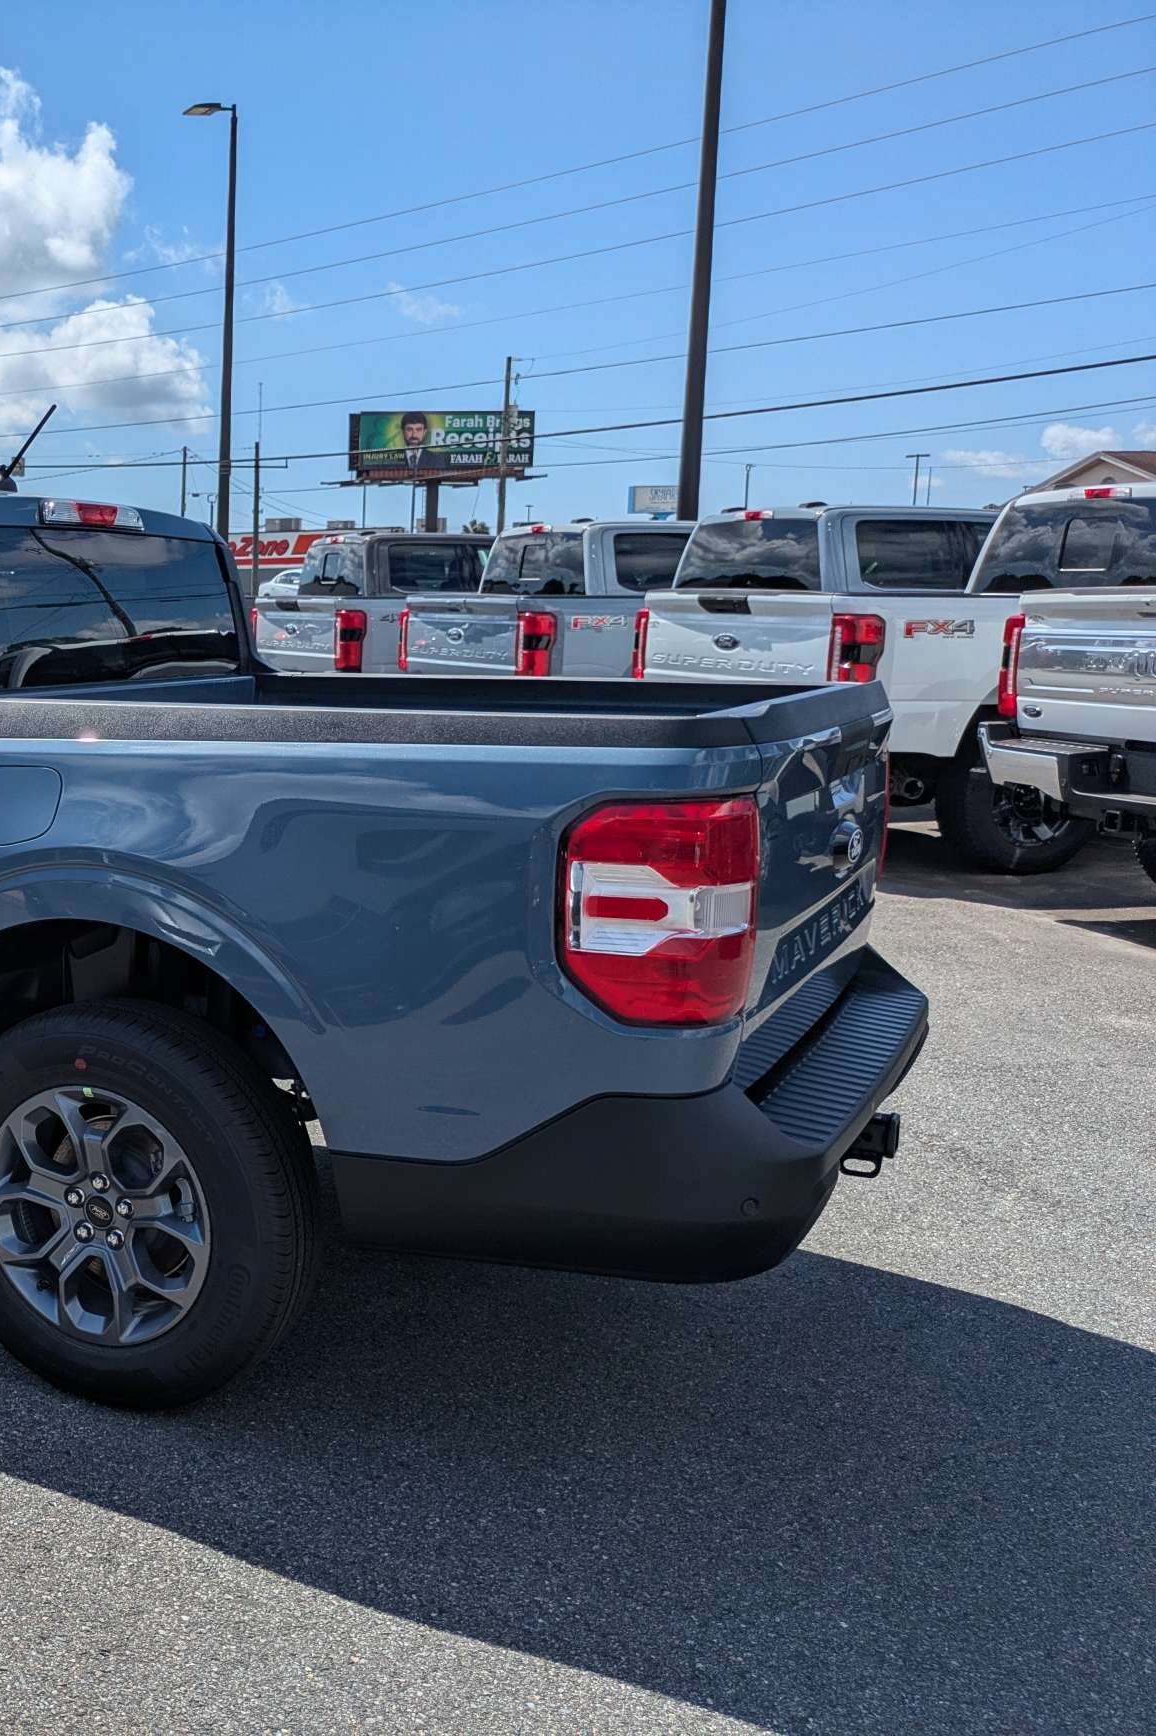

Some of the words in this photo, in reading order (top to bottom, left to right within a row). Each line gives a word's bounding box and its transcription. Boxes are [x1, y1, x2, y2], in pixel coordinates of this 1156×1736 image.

[445, 415, 483, 428] Farah
[450, 453, 483, 464] FARAH
[497, 453, 530, 464] FRAH
[571, 615, 628, 632] FX4
[903, 619, 975, 639] FX4
[258, 639, 294, 649] SUPER
[296, 641, 330, 651] DUTY
[410, 645, 461, 658] SUPER
[462, 648, 509, 661] DUTY
[651, 651, 733, 670] SUPER
[733, 658, 817, 677] DUTY
[771, 884, 864, 985] MAVERICK
